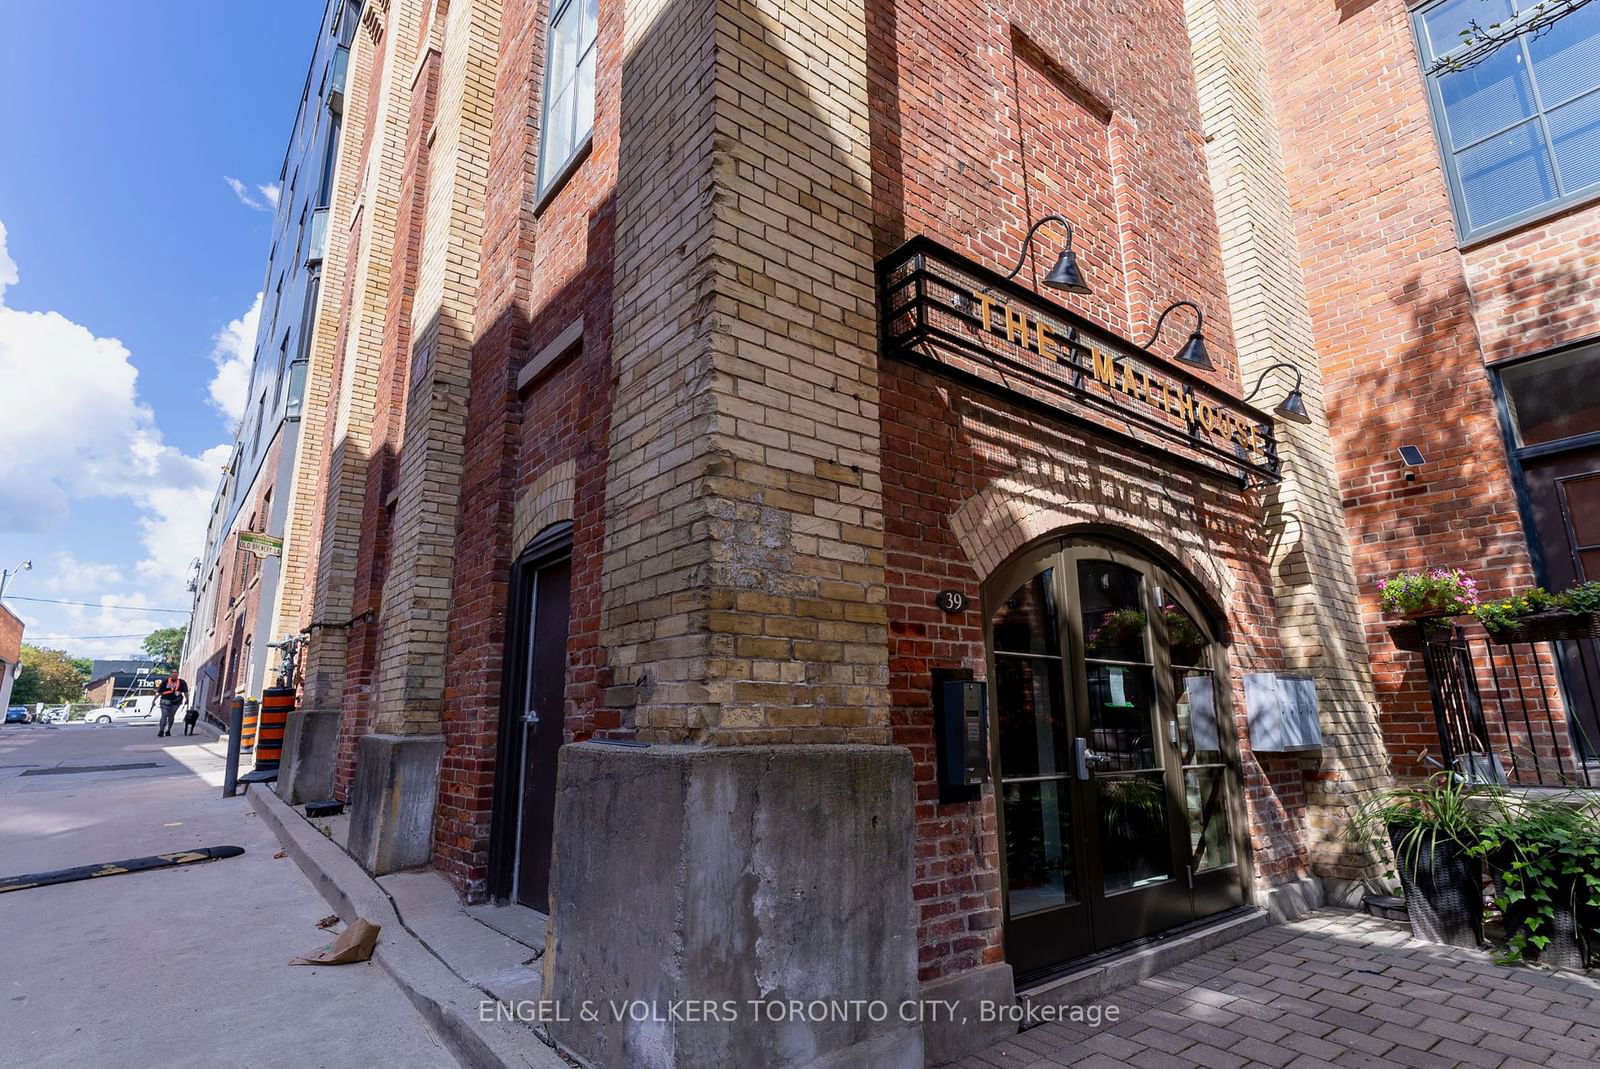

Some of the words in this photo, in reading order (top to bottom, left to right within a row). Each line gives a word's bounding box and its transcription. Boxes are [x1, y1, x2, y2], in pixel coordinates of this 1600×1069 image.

[973, 289, 1057, 361] THE
[1092, 347, 1264, 456] MALTHOUSE
[945, 592, 961, 609] 39
[137, 678, 154, 687] The
